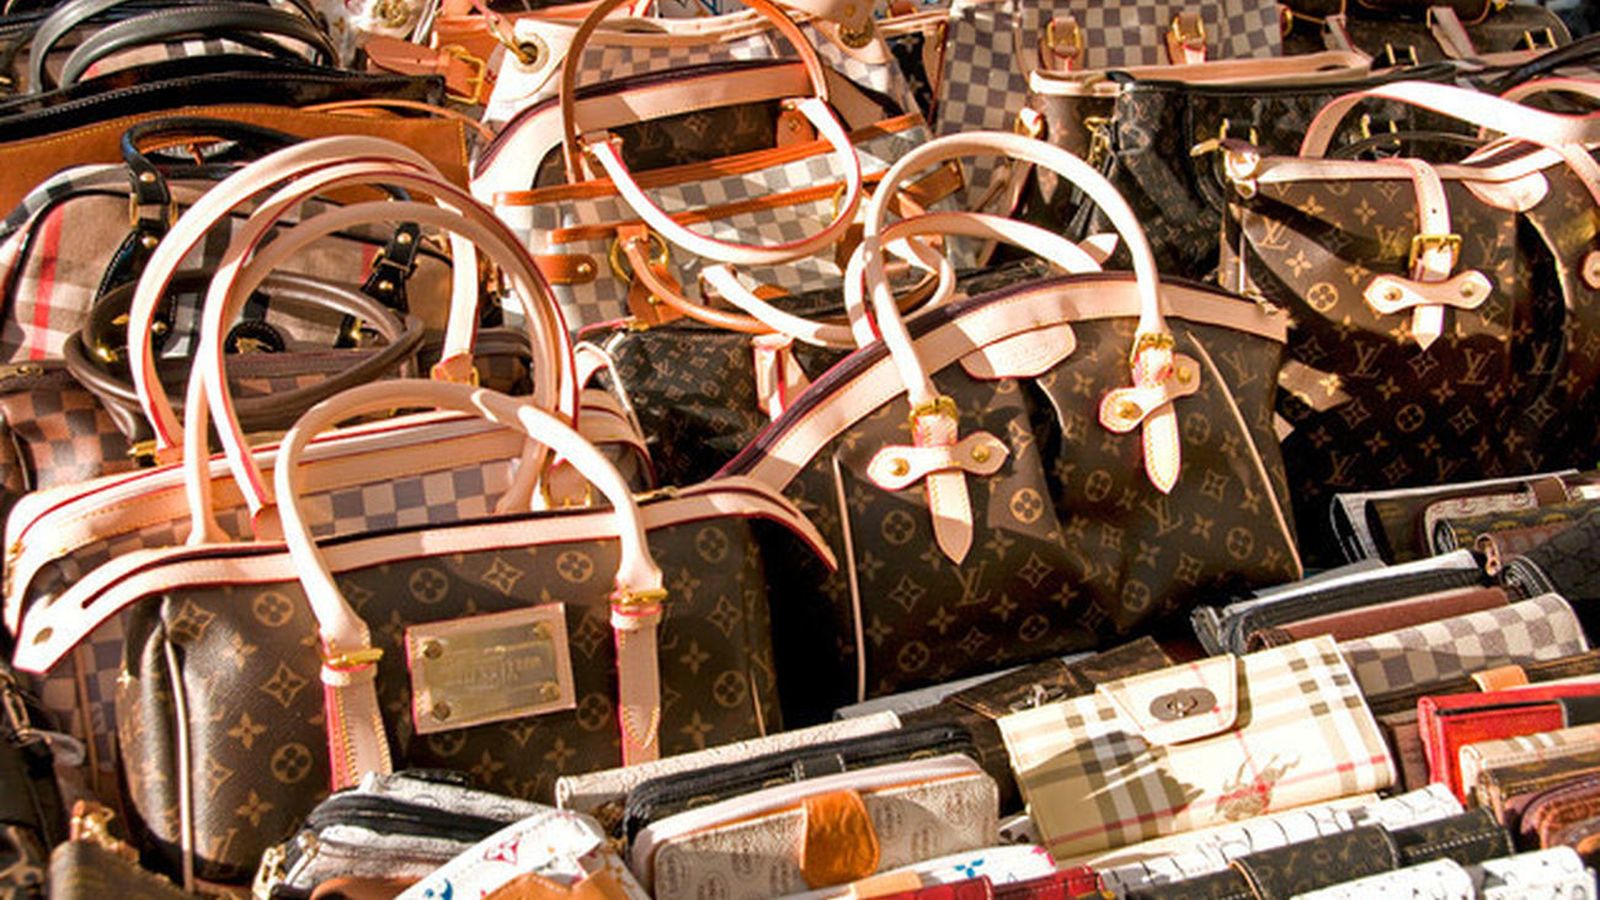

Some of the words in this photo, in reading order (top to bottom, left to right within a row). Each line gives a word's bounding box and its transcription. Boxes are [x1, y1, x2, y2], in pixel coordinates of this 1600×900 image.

[1258, 216, 1291, 249] LV
[1347, 340, 1387, 379] LV
[1457, 348, 1496, 385] LV
[1323, 450, 1361, 487] LV
[1141, 498, 1183, 537] LV
[951, 559, 993, 606] LV
